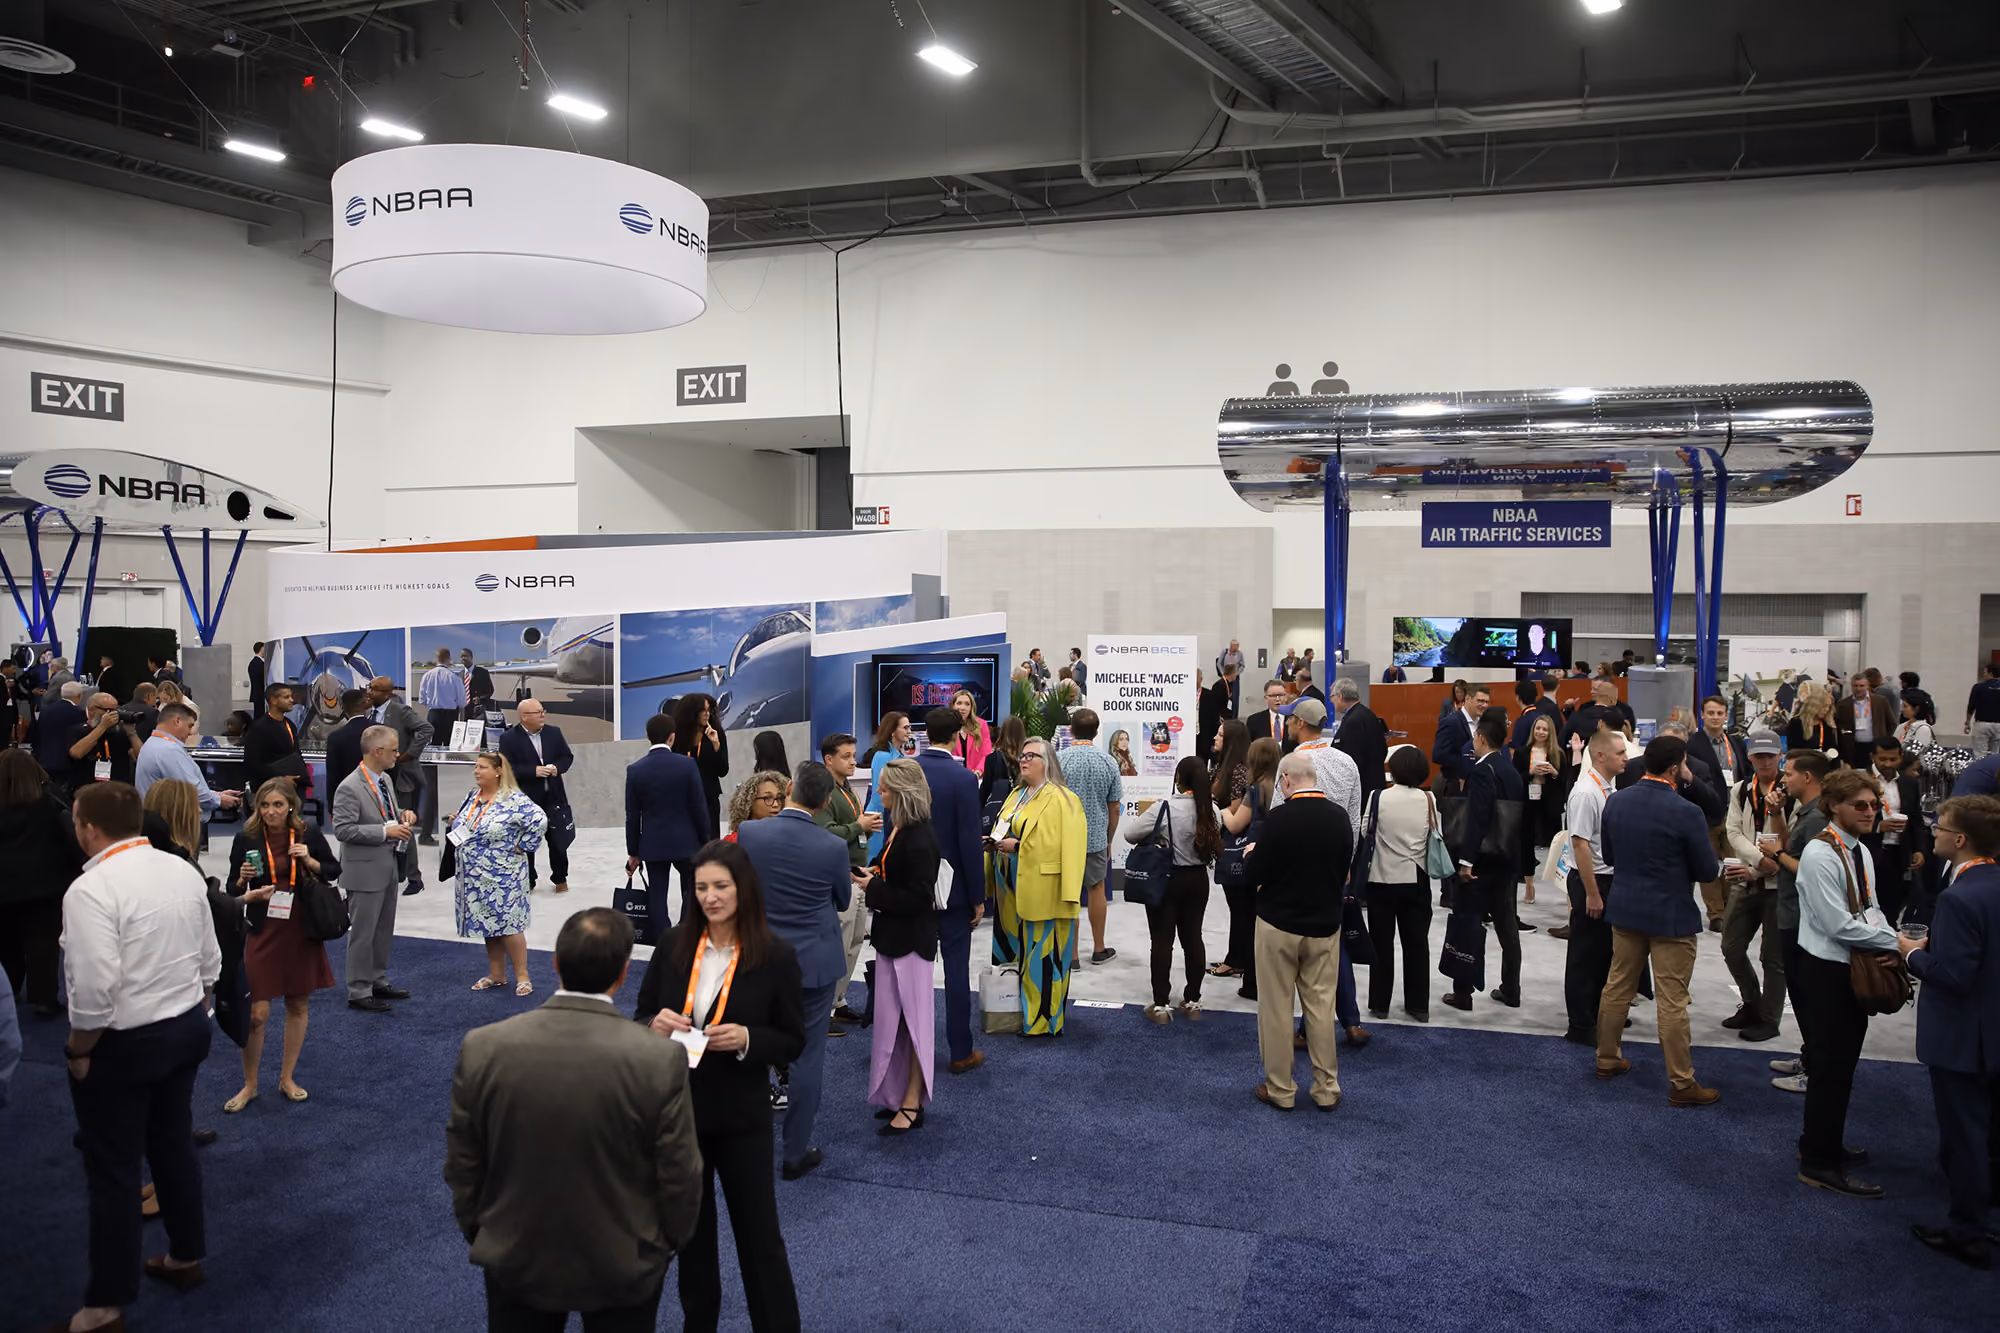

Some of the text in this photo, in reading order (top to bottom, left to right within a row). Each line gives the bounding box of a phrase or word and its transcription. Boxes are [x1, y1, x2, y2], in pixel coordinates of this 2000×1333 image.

[372, 187, 473, 216] NBAA
[660, 217, 706, 256] NBAA
[682, 371, 742, 400] EXIT
[40, 378, 119, 414] EXIT
[99, 474, 205, 505] NBAA
[855, 514, 876, 522] W408
[1492, 508, 1538, 523] NBAA
[1430, 526, 1602, 542] AIR TRAFFIC SERVICES
[505, 575, 575, 588] NBAA
[1095, 673, 1189, 684] MICHELLE "MACE"
[1119, 687, 1164, 698] CURRAN
[1103, 700, 1179, 712] BOOK SIGNING
